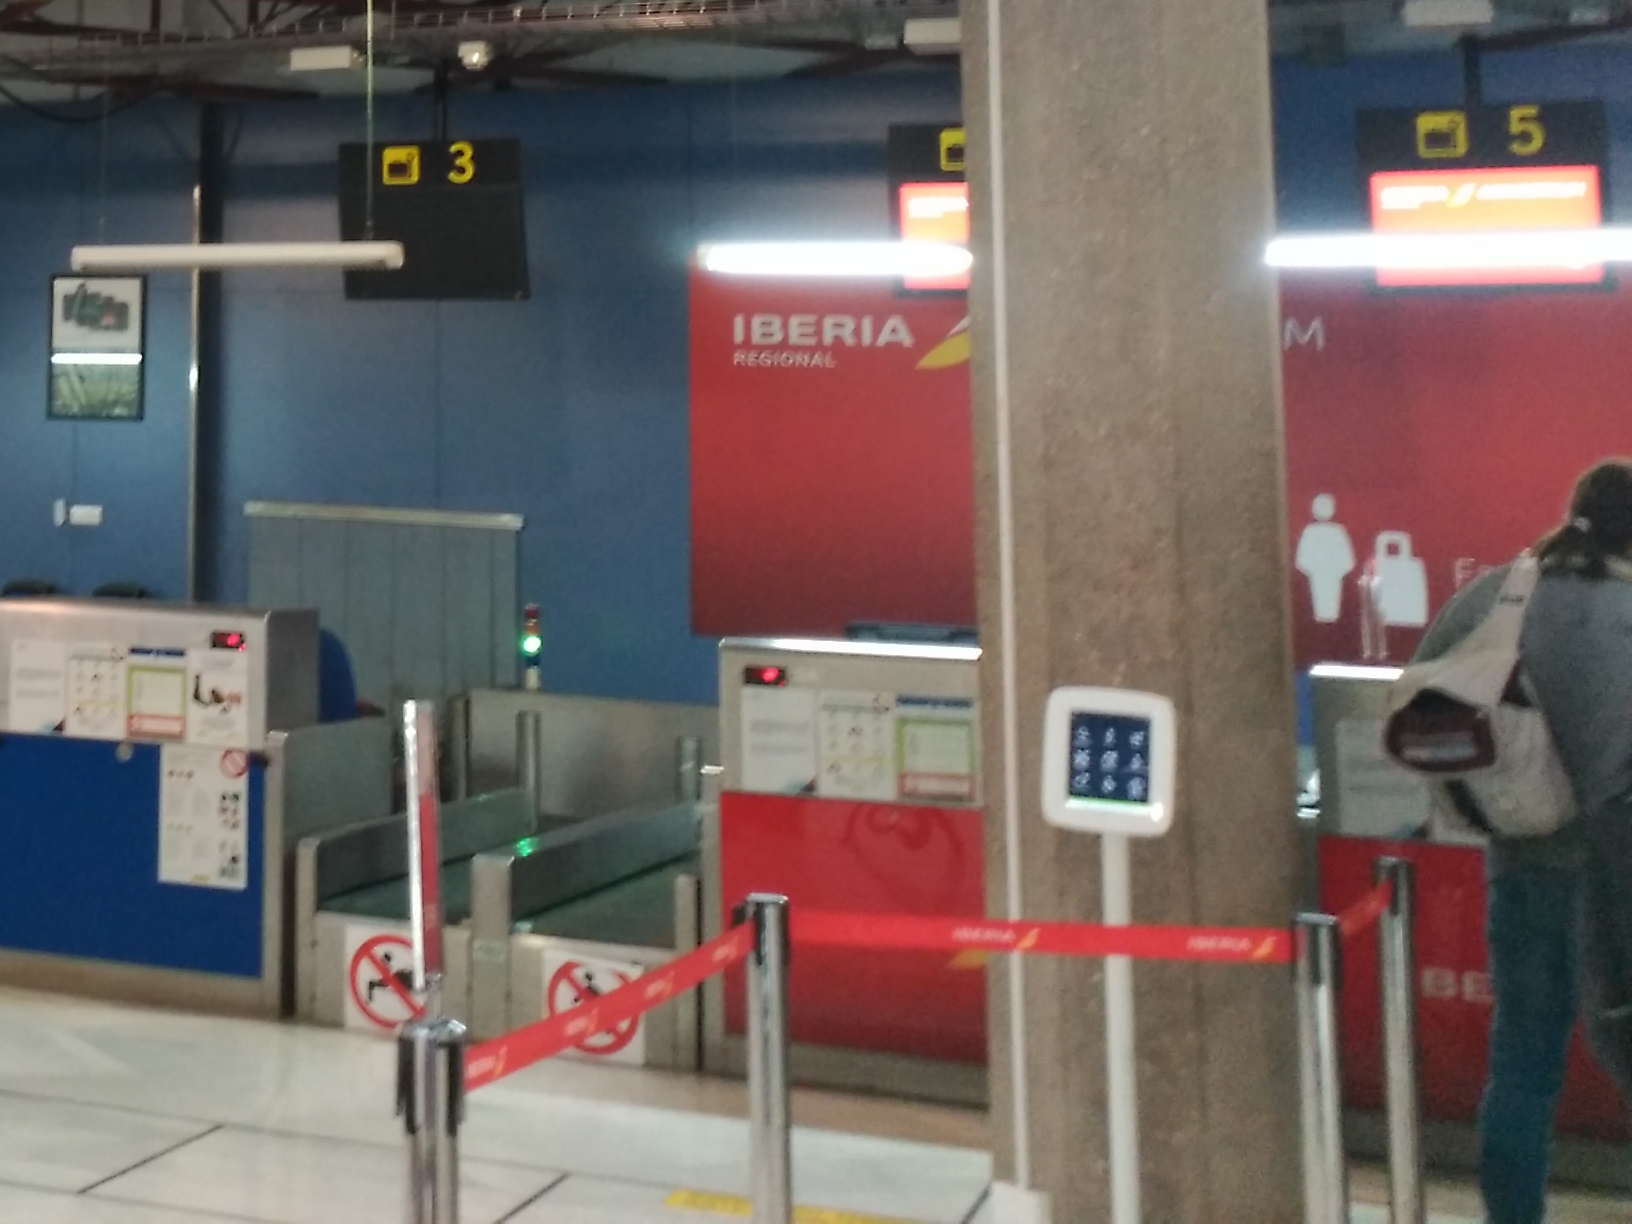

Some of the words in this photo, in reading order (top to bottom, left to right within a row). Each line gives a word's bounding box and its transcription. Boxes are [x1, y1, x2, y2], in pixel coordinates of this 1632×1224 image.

[1508, 105, 1546, 156] 5
[447, 141, 476, 184] 3
[732, 312, 916, 348] IBERIA
[732, 349, 837, 369] REGIONAL
